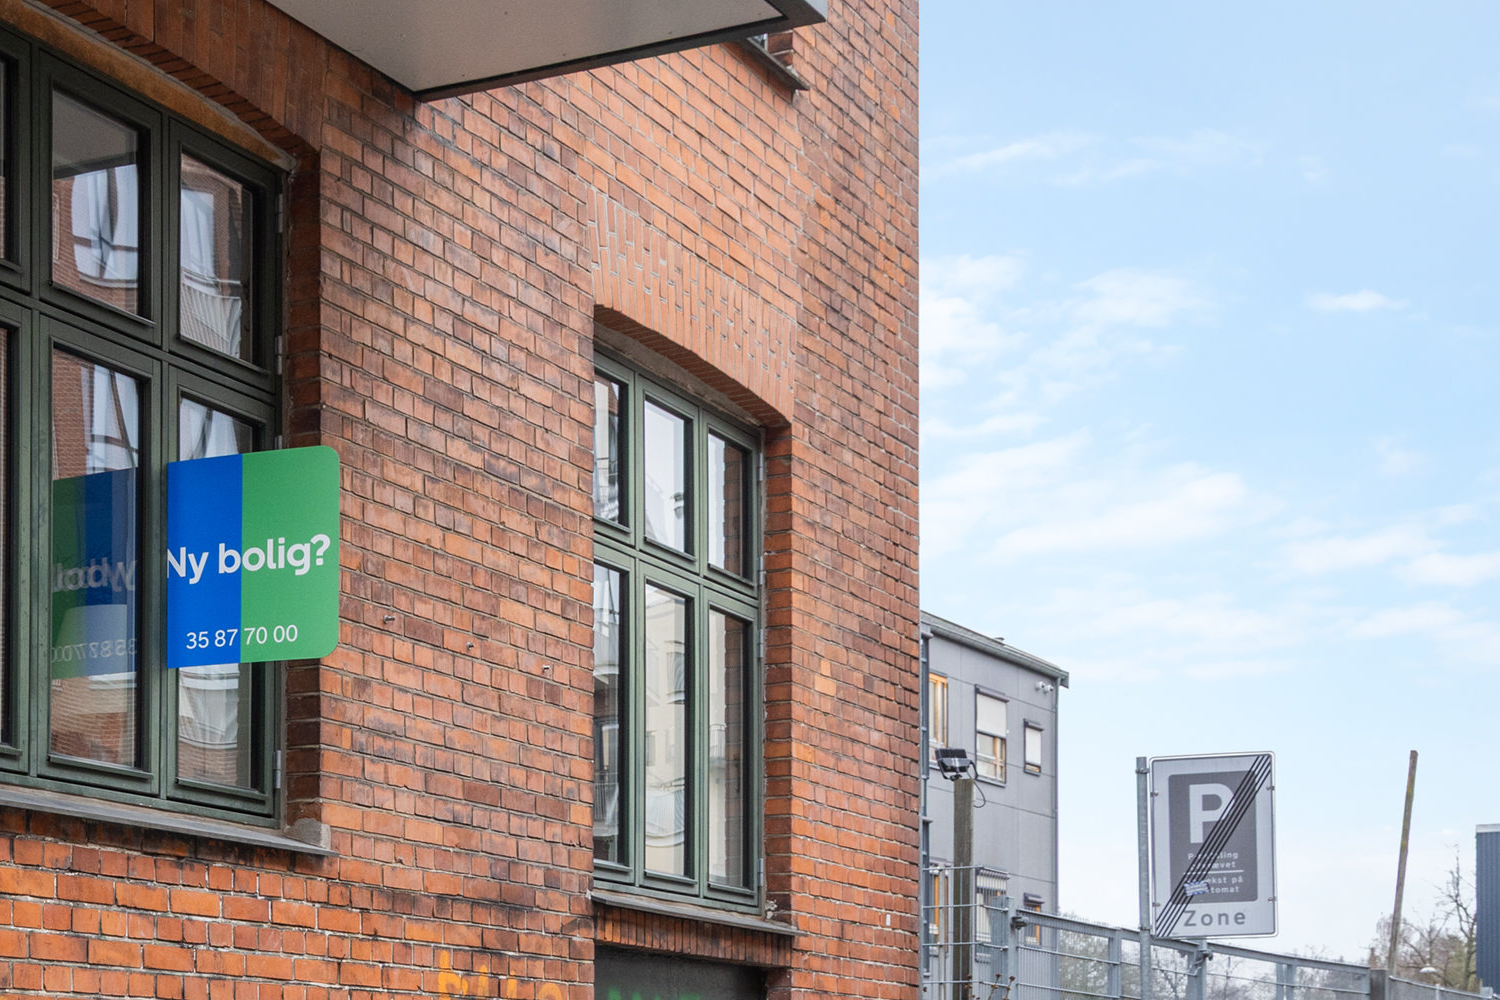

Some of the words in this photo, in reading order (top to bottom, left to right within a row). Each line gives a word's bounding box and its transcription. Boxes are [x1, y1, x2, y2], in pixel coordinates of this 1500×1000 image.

[167, 547, 209, 585] Ny
[218, 534, 331, 576] bolig?
[186, 631, 209, 649] 35
[214, 629, 238, 647] 87
[243, 626, 268, 645] 70
[273, 624, 298, 643] 00
[1189, 783, 1234, 844] P
[1184, 910, 1246, 927] Zone
